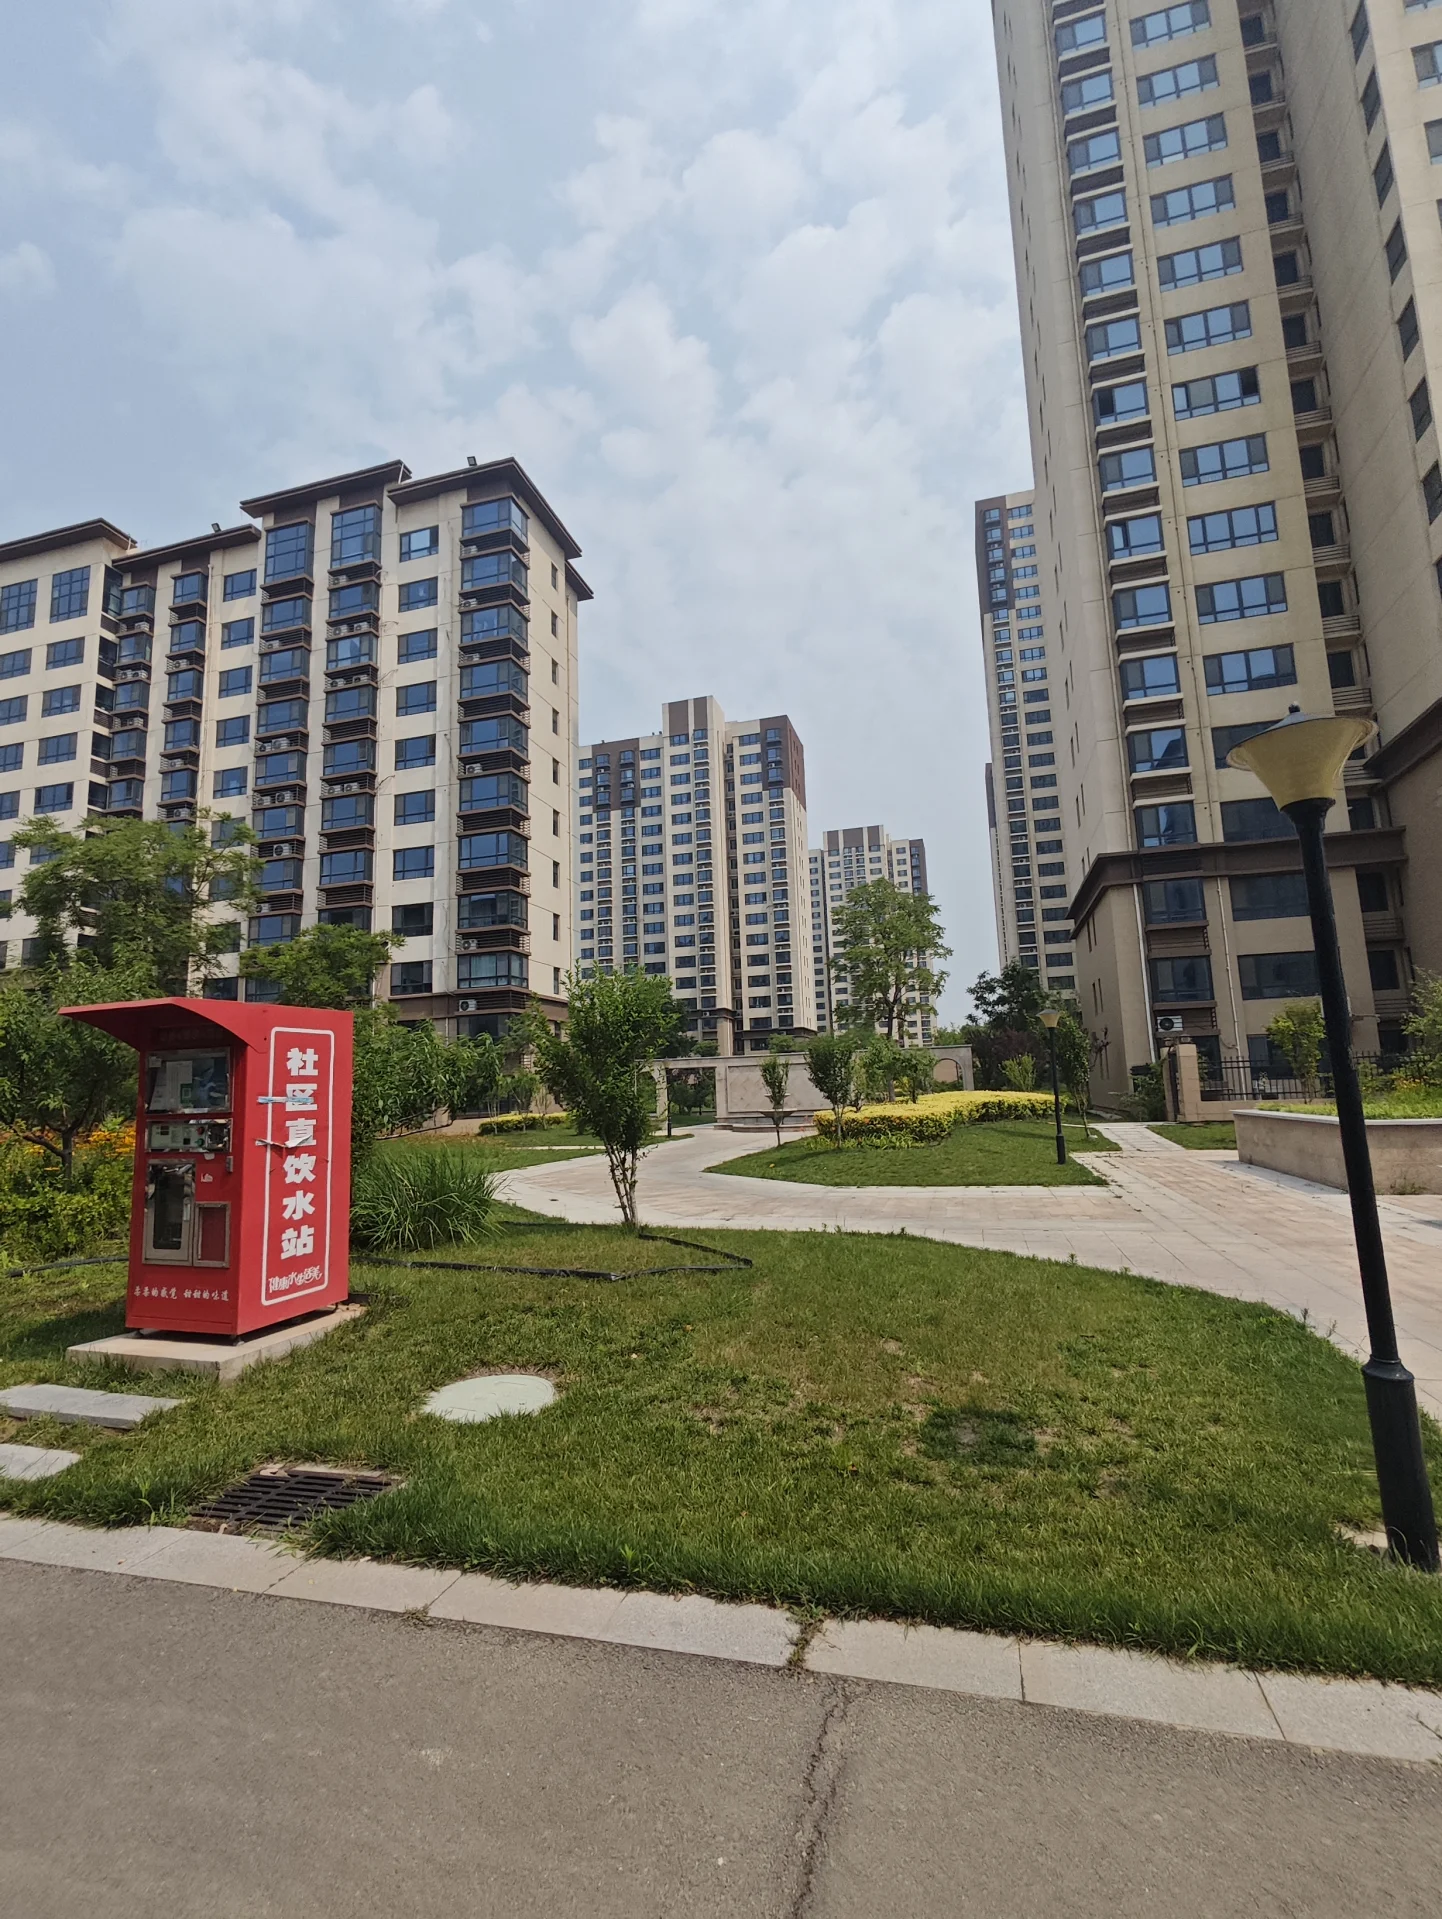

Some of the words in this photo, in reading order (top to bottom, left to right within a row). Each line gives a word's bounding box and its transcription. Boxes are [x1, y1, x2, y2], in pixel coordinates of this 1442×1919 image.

[281, 1048, 319, 1259] 社区直饮水站
